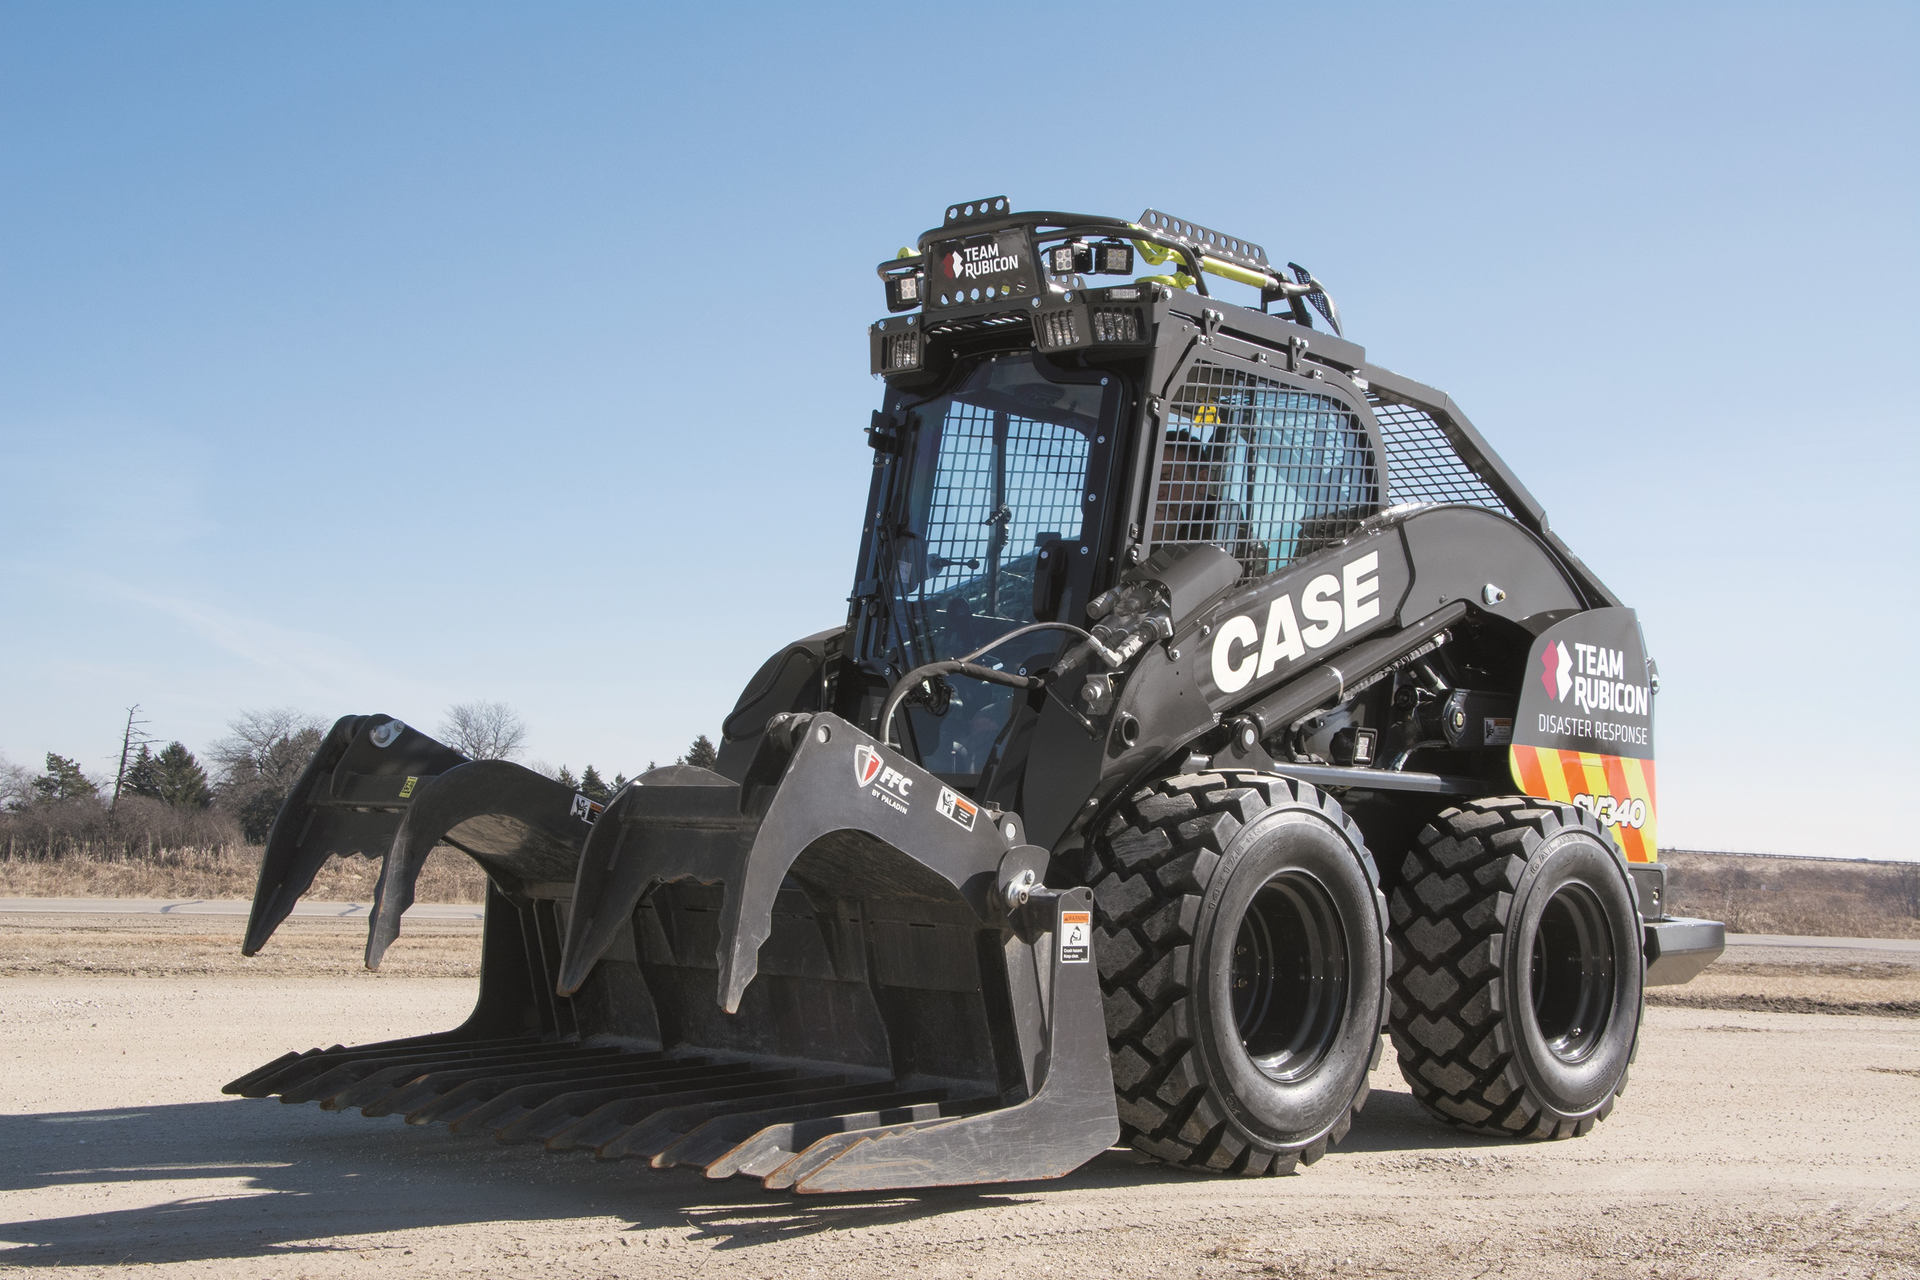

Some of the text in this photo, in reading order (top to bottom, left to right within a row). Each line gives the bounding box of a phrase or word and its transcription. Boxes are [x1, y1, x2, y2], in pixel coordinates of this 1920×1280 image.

[964, 243, 999, 261] TEAM
[965, 255, 1019, 279] RUBICON
[1211, 550, 1380, 693] CASE
[1575, 643, 1624, 680] TEAM
[1575, 676, 1648, 716] RUBICON
[1538, 713, 1648, 745] DISASTER RESPONSE
[879, 766, 913, 797] FFC
[871, 789, 908, 815] BY PALADIN
[1573, 793, 1646, 829] SV340
